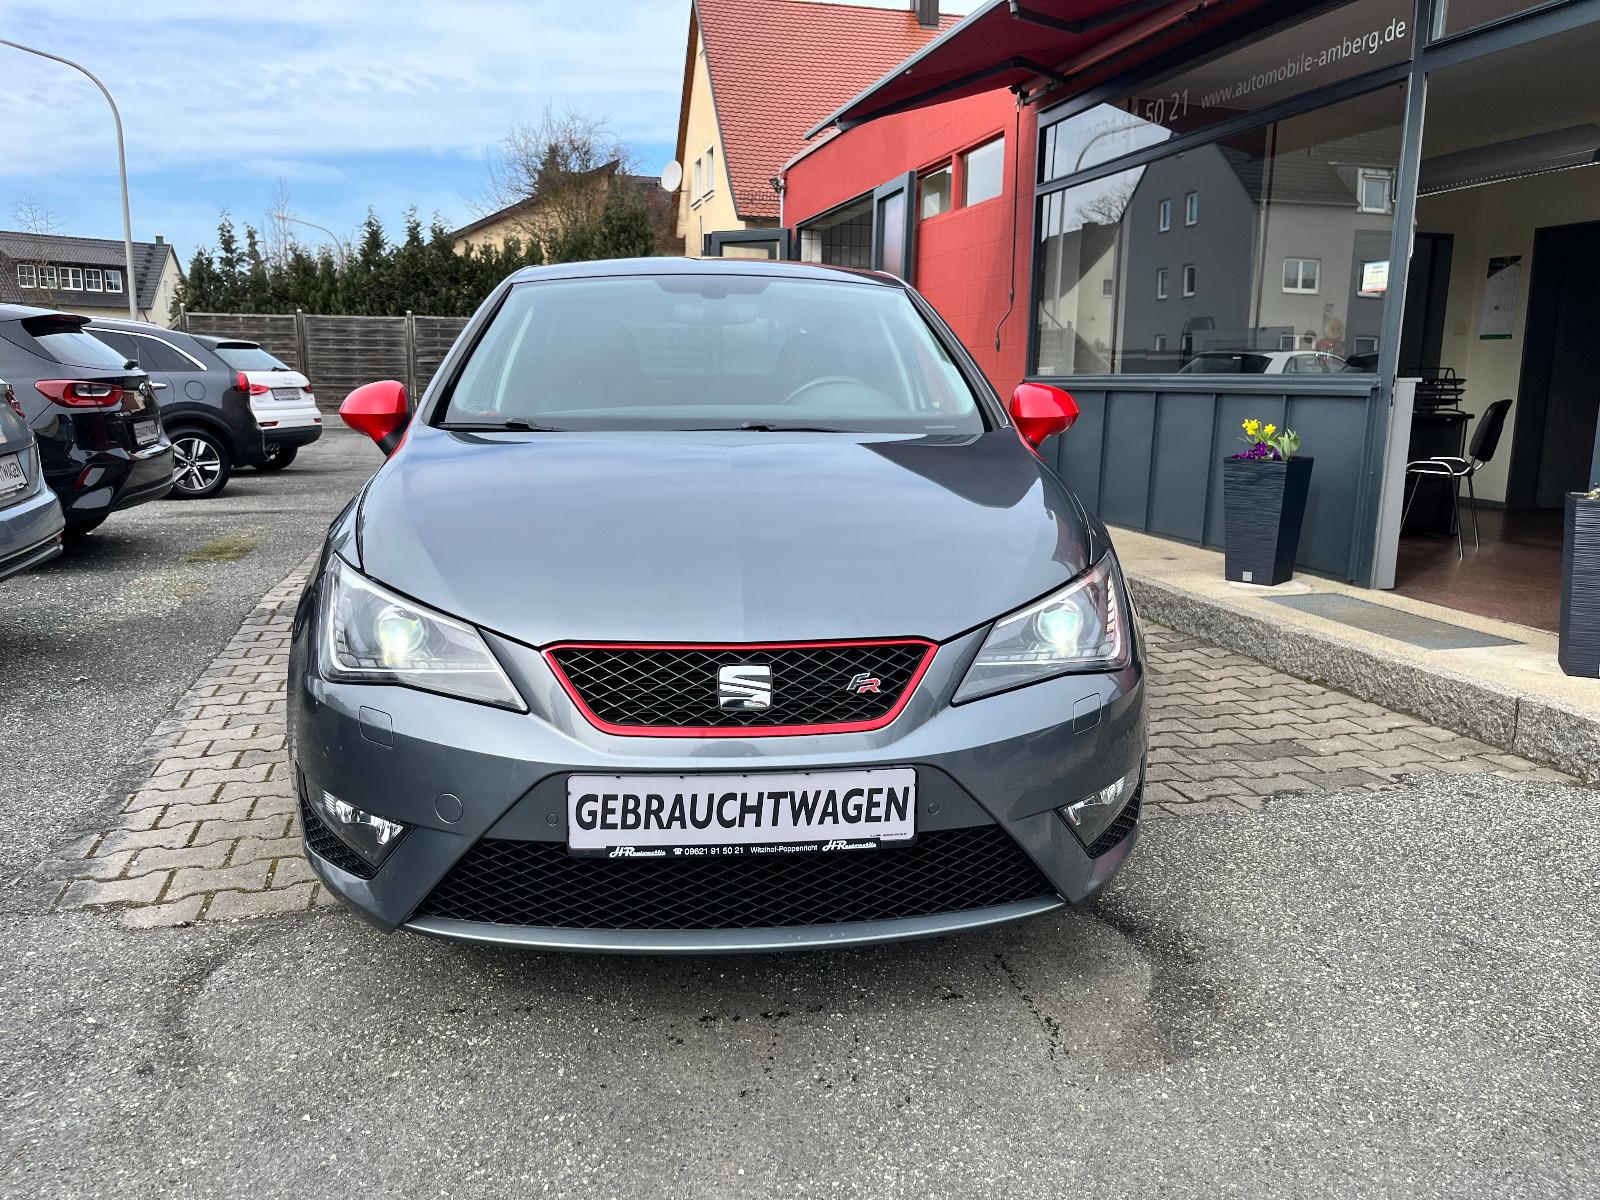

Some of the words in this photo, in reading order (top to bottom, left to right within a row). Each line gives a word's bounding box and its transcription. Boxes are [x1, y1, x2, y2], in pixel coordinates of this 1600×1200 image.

[1145, 99, 1165, 124] 50
[1169, 89, 1189, 121] 21
[1200, 17, 1407, 110] www.automobile-amberg.de
[845, 672, 881, 694] FR
[575, 786, 910, 831] GEBRAUCHTWAGEN
[684, 847, 708, 856] 09621
[710, 847, 720, 855] 91
[722, 846, 733, 855] 50
[735, 846, 744, 854] 21
